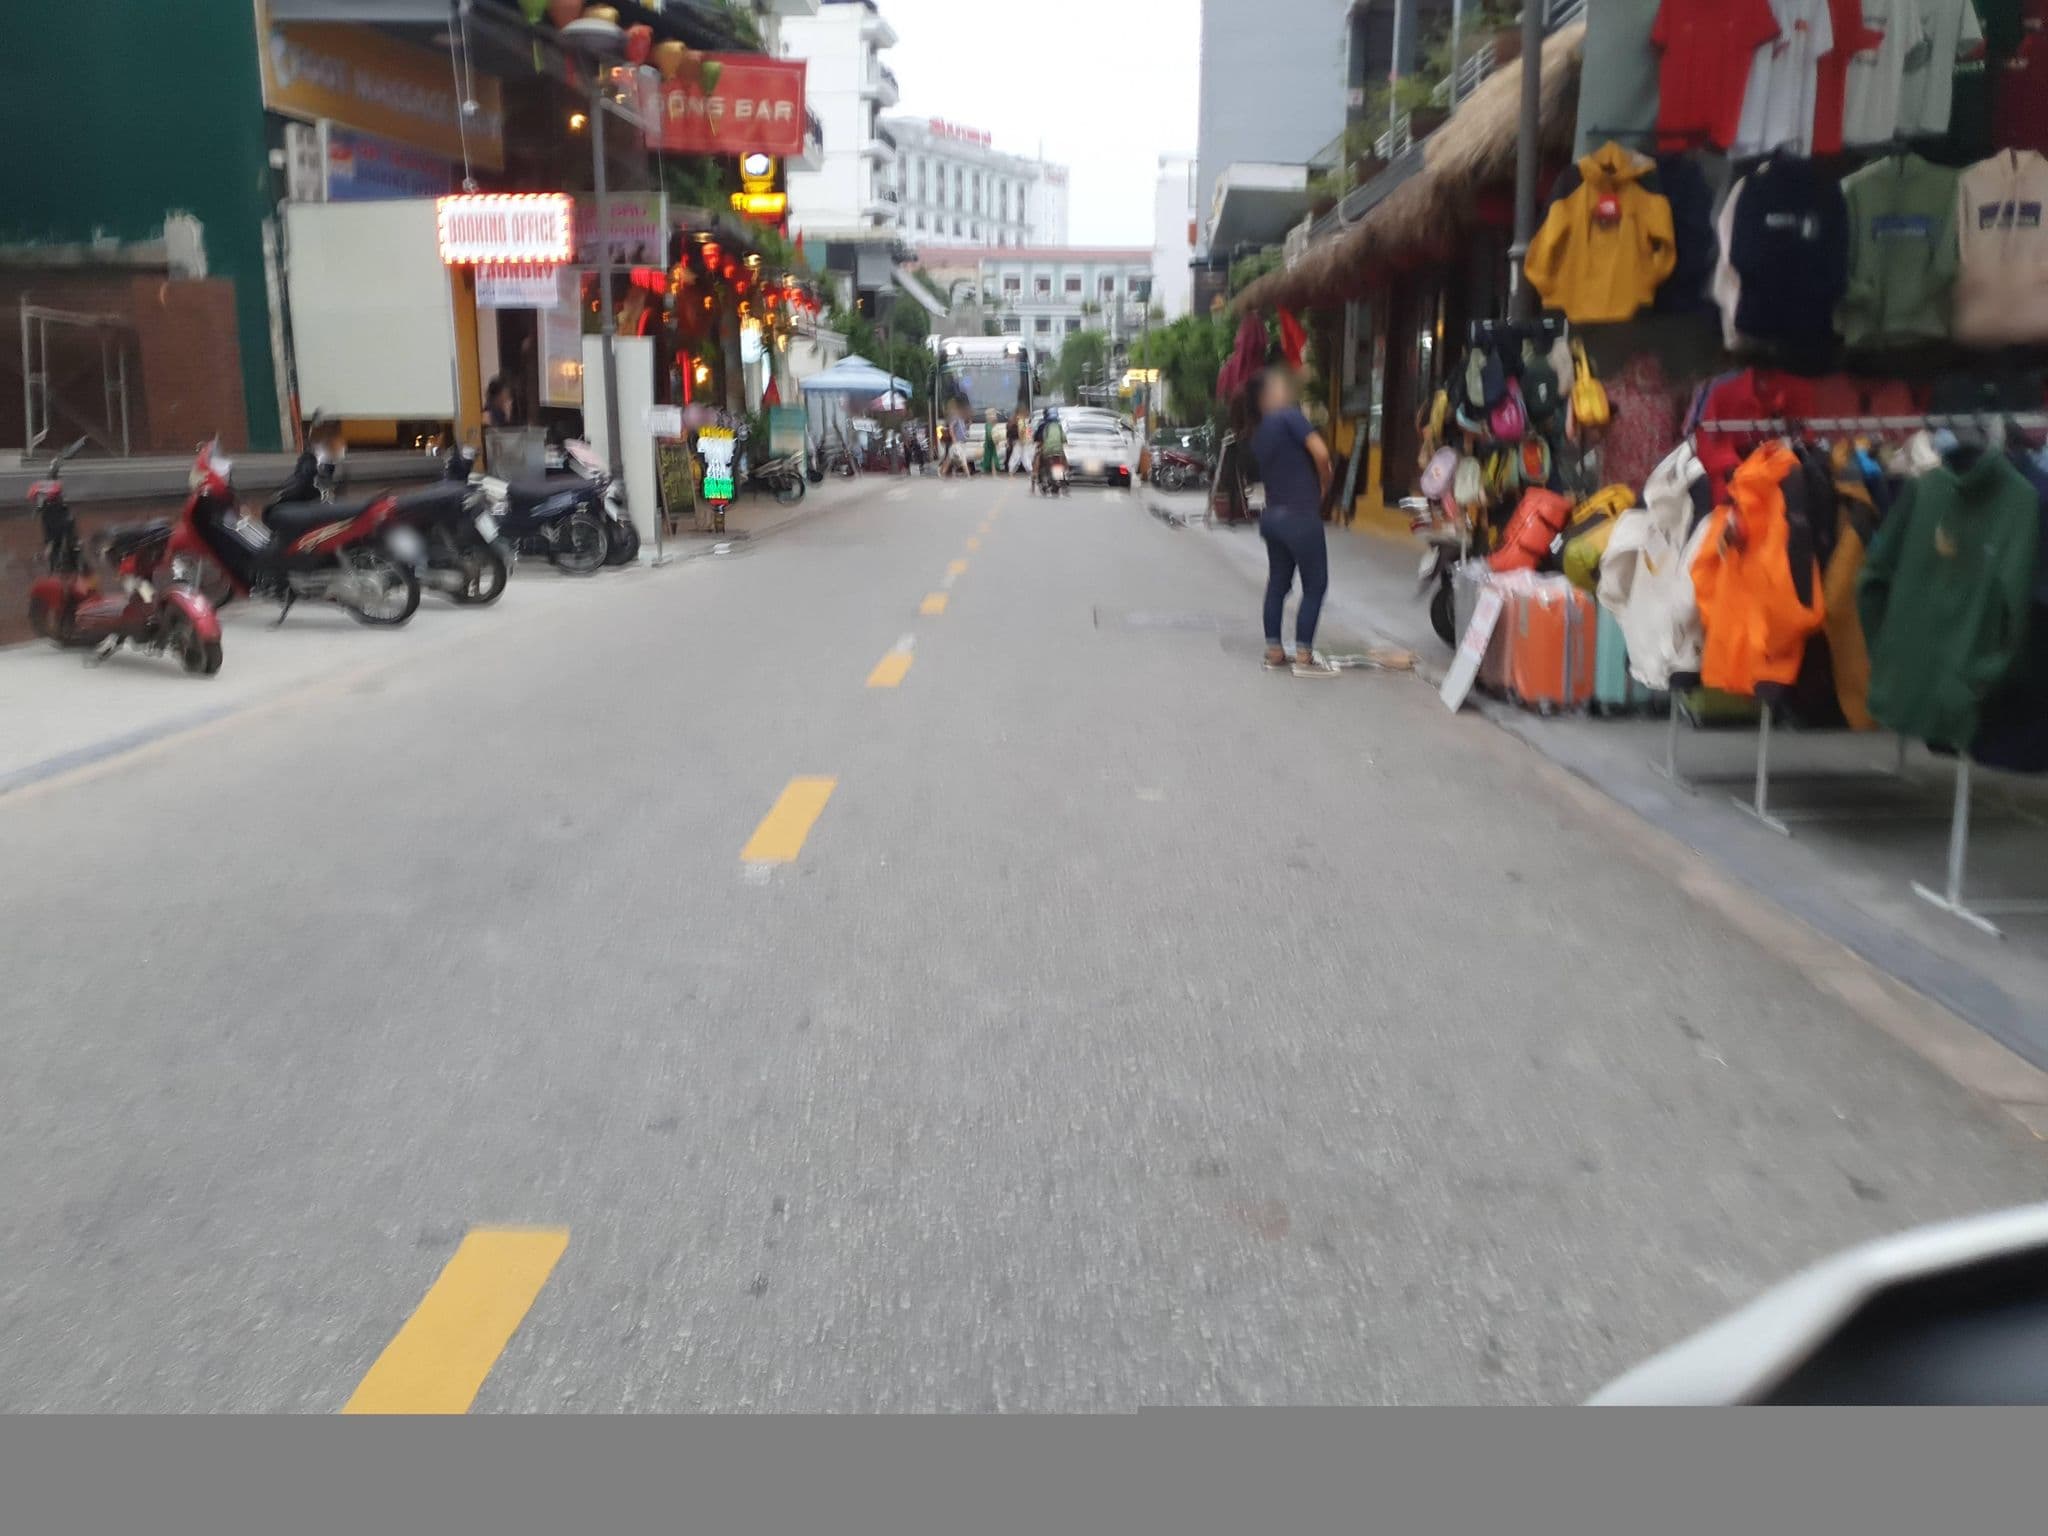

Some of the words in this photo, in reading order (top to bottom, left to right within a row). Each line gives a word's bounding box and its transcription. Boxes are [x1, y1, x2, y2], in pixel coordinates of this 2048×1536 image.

[735, 98, 794, 122] BAR
[448, 211, 507, 245] BOOKING
[511, 211, 557, 246] OFFICE
